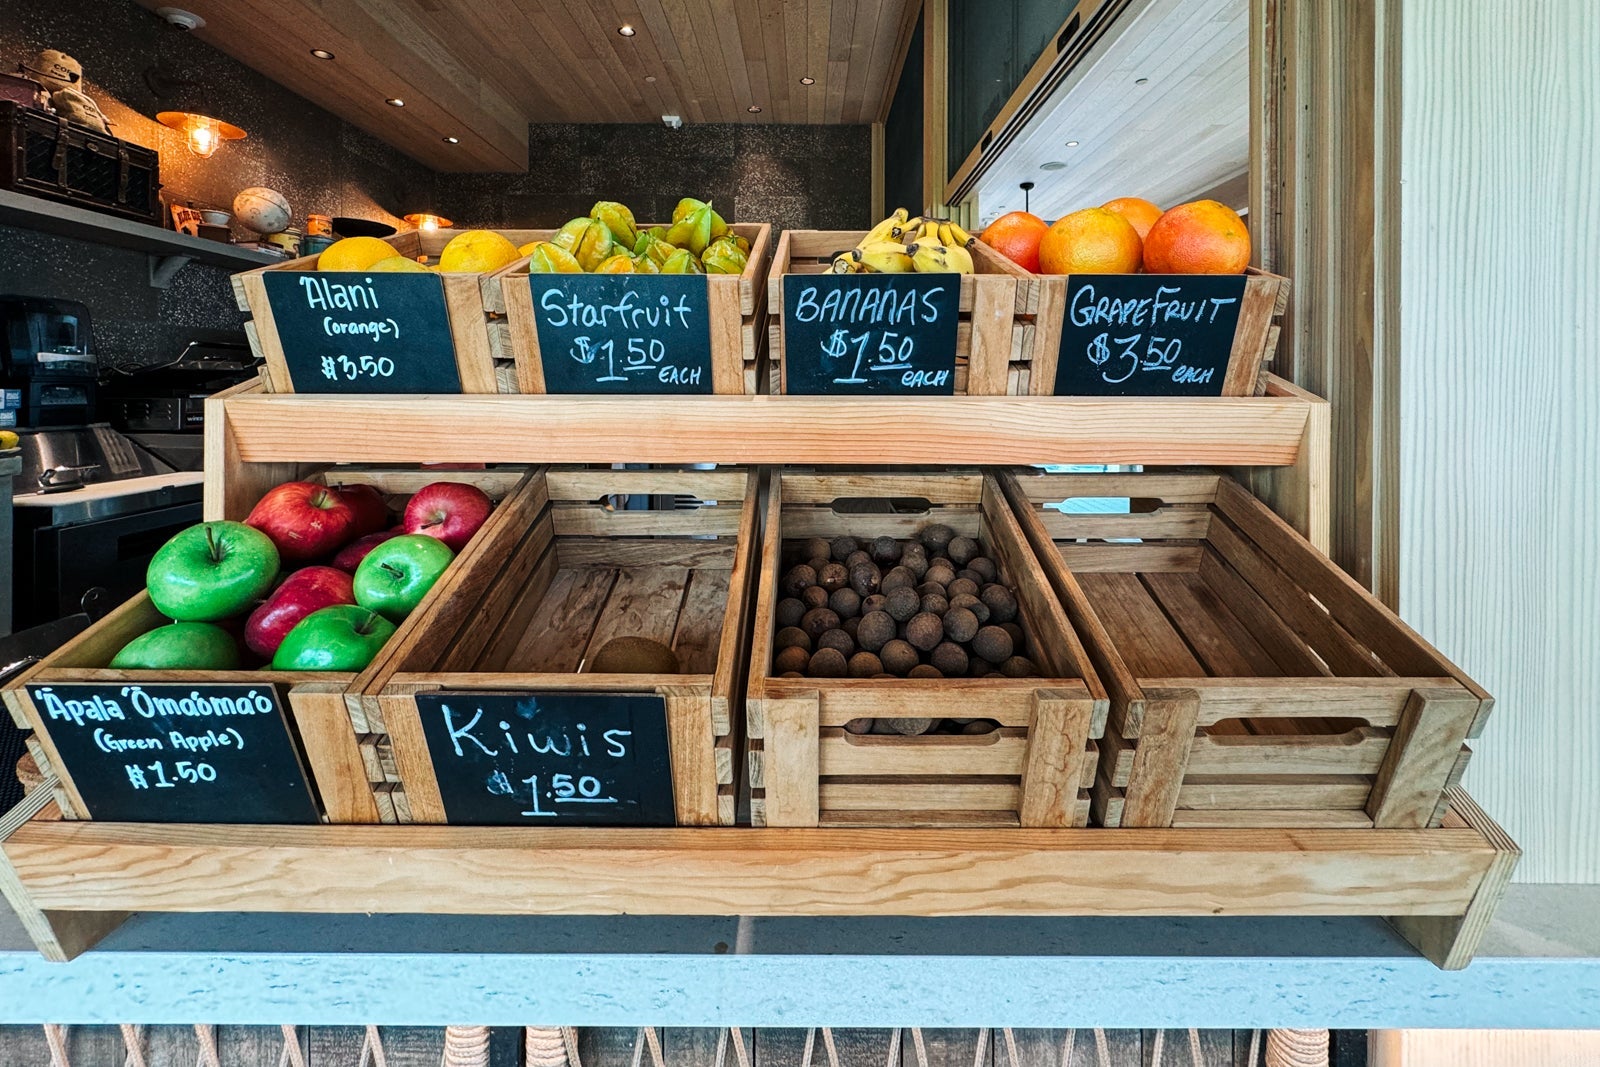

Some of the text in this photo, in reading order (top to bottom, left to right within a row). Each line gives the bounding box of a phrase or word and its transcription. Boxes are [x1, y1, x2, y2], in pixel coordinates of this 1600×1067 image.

[541, 288, 692, 329] Starfruit
[795, 287, 945, 325] BANANAS
[1070, 284, 1237, 327] GRAPEFRUIT
[323, 317, 399, 342] (orange)
[321, 355, 395, 380] $3.50
[570, 336, 702, 384] $1.50 EACH
[820, 329, 914, 384] $1.50
[1086, 332, 1182, 383] $3.50
[94, 728, 244, 752] (Green Apple)
[441, 704, 632, 757] Kiwis
[125, 761, 216, 789] $1.50
